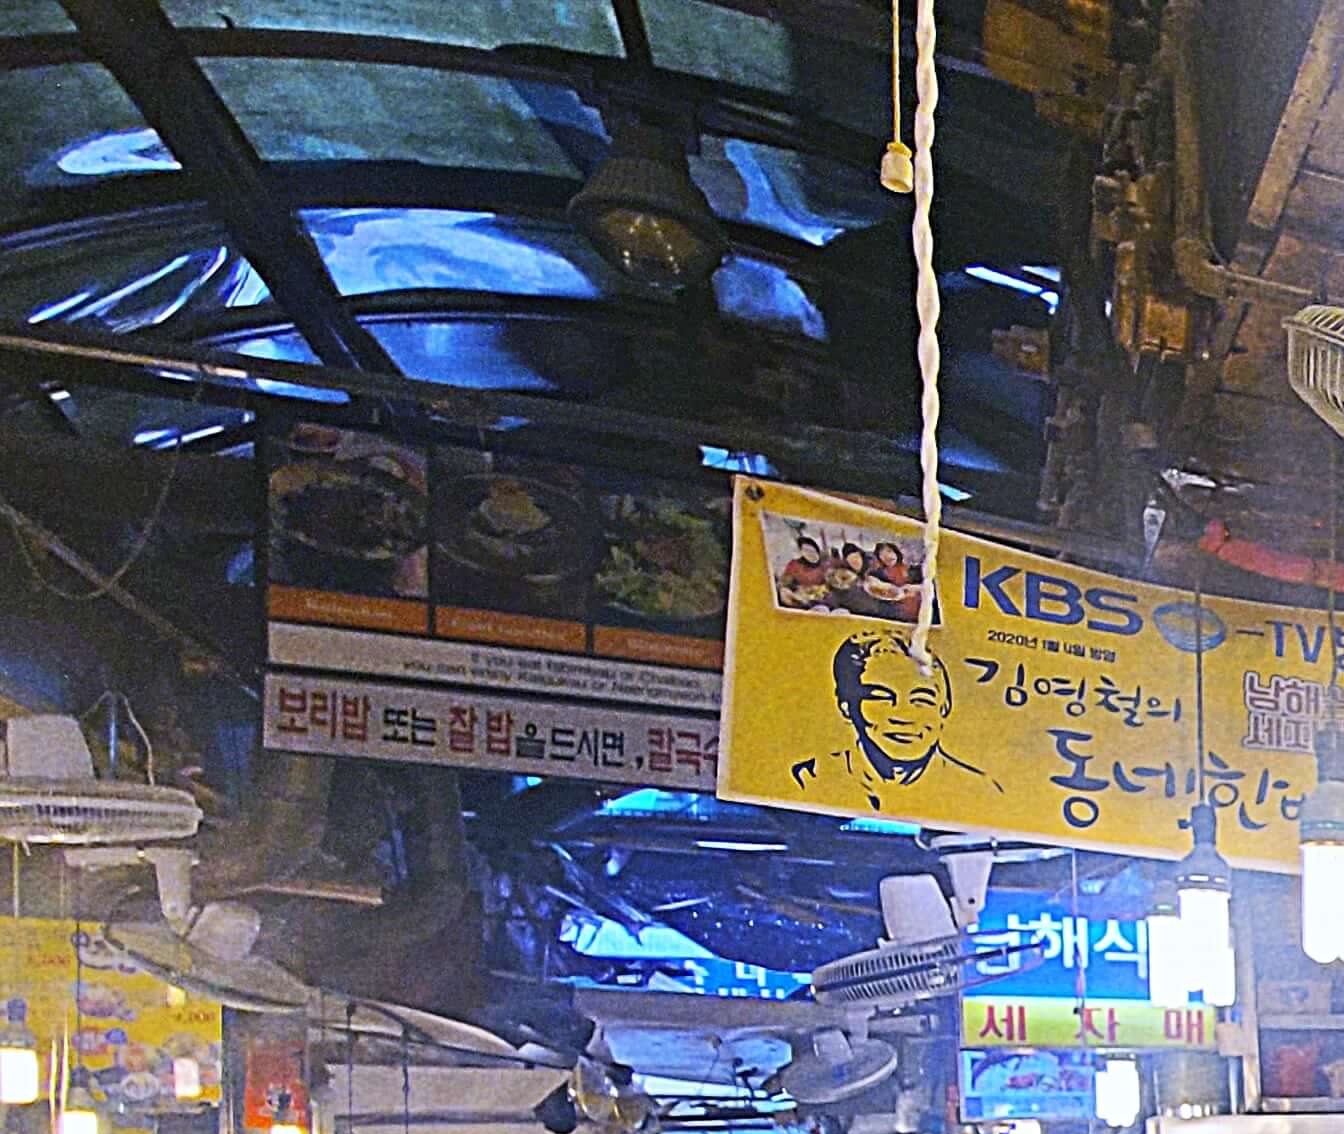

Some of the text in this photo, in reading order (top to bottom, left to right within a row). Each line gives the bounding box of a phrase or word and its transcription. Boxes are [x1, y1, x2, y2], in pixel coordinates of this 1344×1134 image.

[961, 554, 1144, 638] KBS
[987, 629, 1038, 650] 2020년
[278, 686, 370, 742] 보리밥
[382, 706, 437, 748] 또는
[963, 656, 1183, 728] 김영철의
